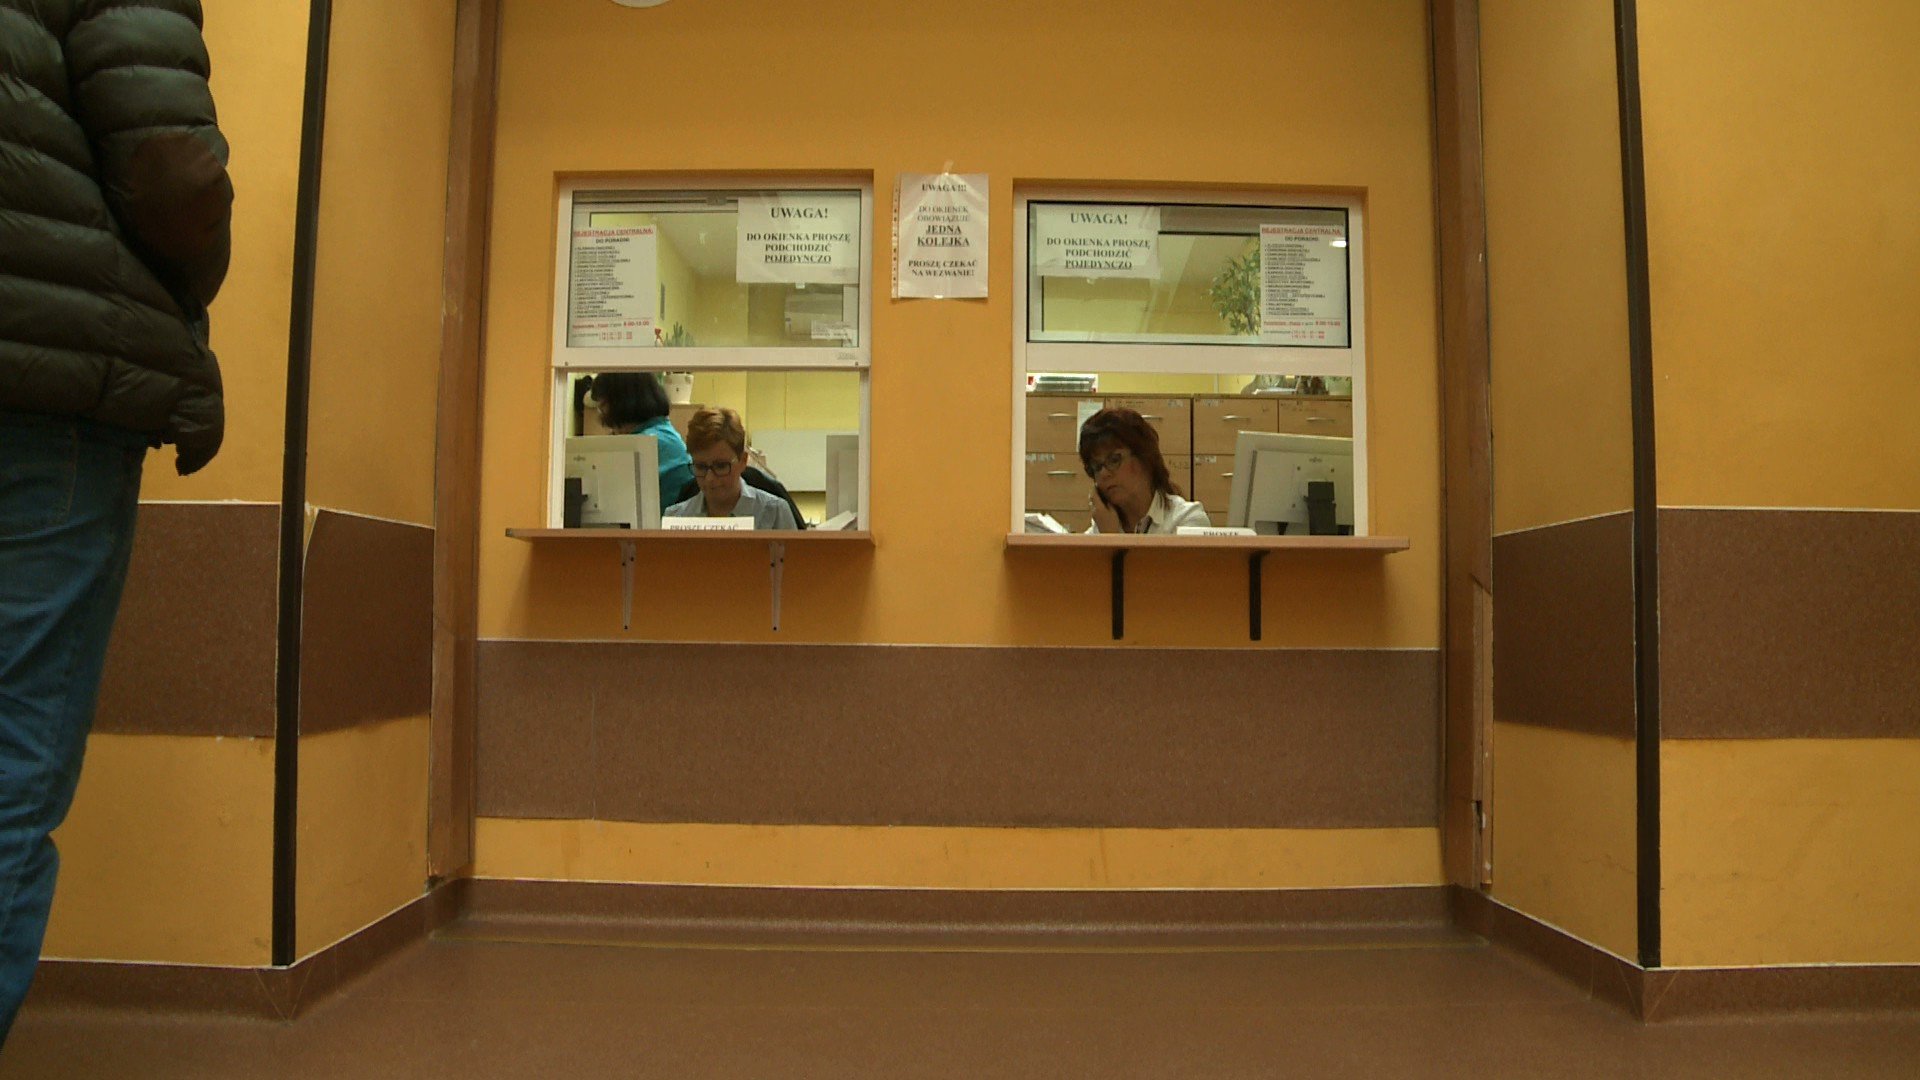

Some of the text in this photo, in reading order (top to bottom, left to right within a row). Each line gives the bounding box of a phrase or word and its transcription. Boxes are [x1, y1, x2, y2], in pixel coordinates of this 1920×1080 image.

[771, 207, 828, 219] UWAGA!
[1070, 213, 1128, 224] UWAGA!
[925, 224, 962, 235] JEDNA
[763, 233, 810, 241] OKIENKA
[812, 233, 851, 243] PROSZĘ
[917, 236, 969, 247] KOLEJKA
[1046, 237, 1151, 250] DO OKIENKA PROSZĘ
[765, 243, 832, 252] PODCHODZIĆ
[764, 254, 832, 264] POJEDYNCZO
[1065, 249, 1132, 258] PODCHODZIĆ
[908, 259, 976, 269] PROSZĘ CZEKAĆ
[1064, 259, 1133, 270] POJEDYNCZO
